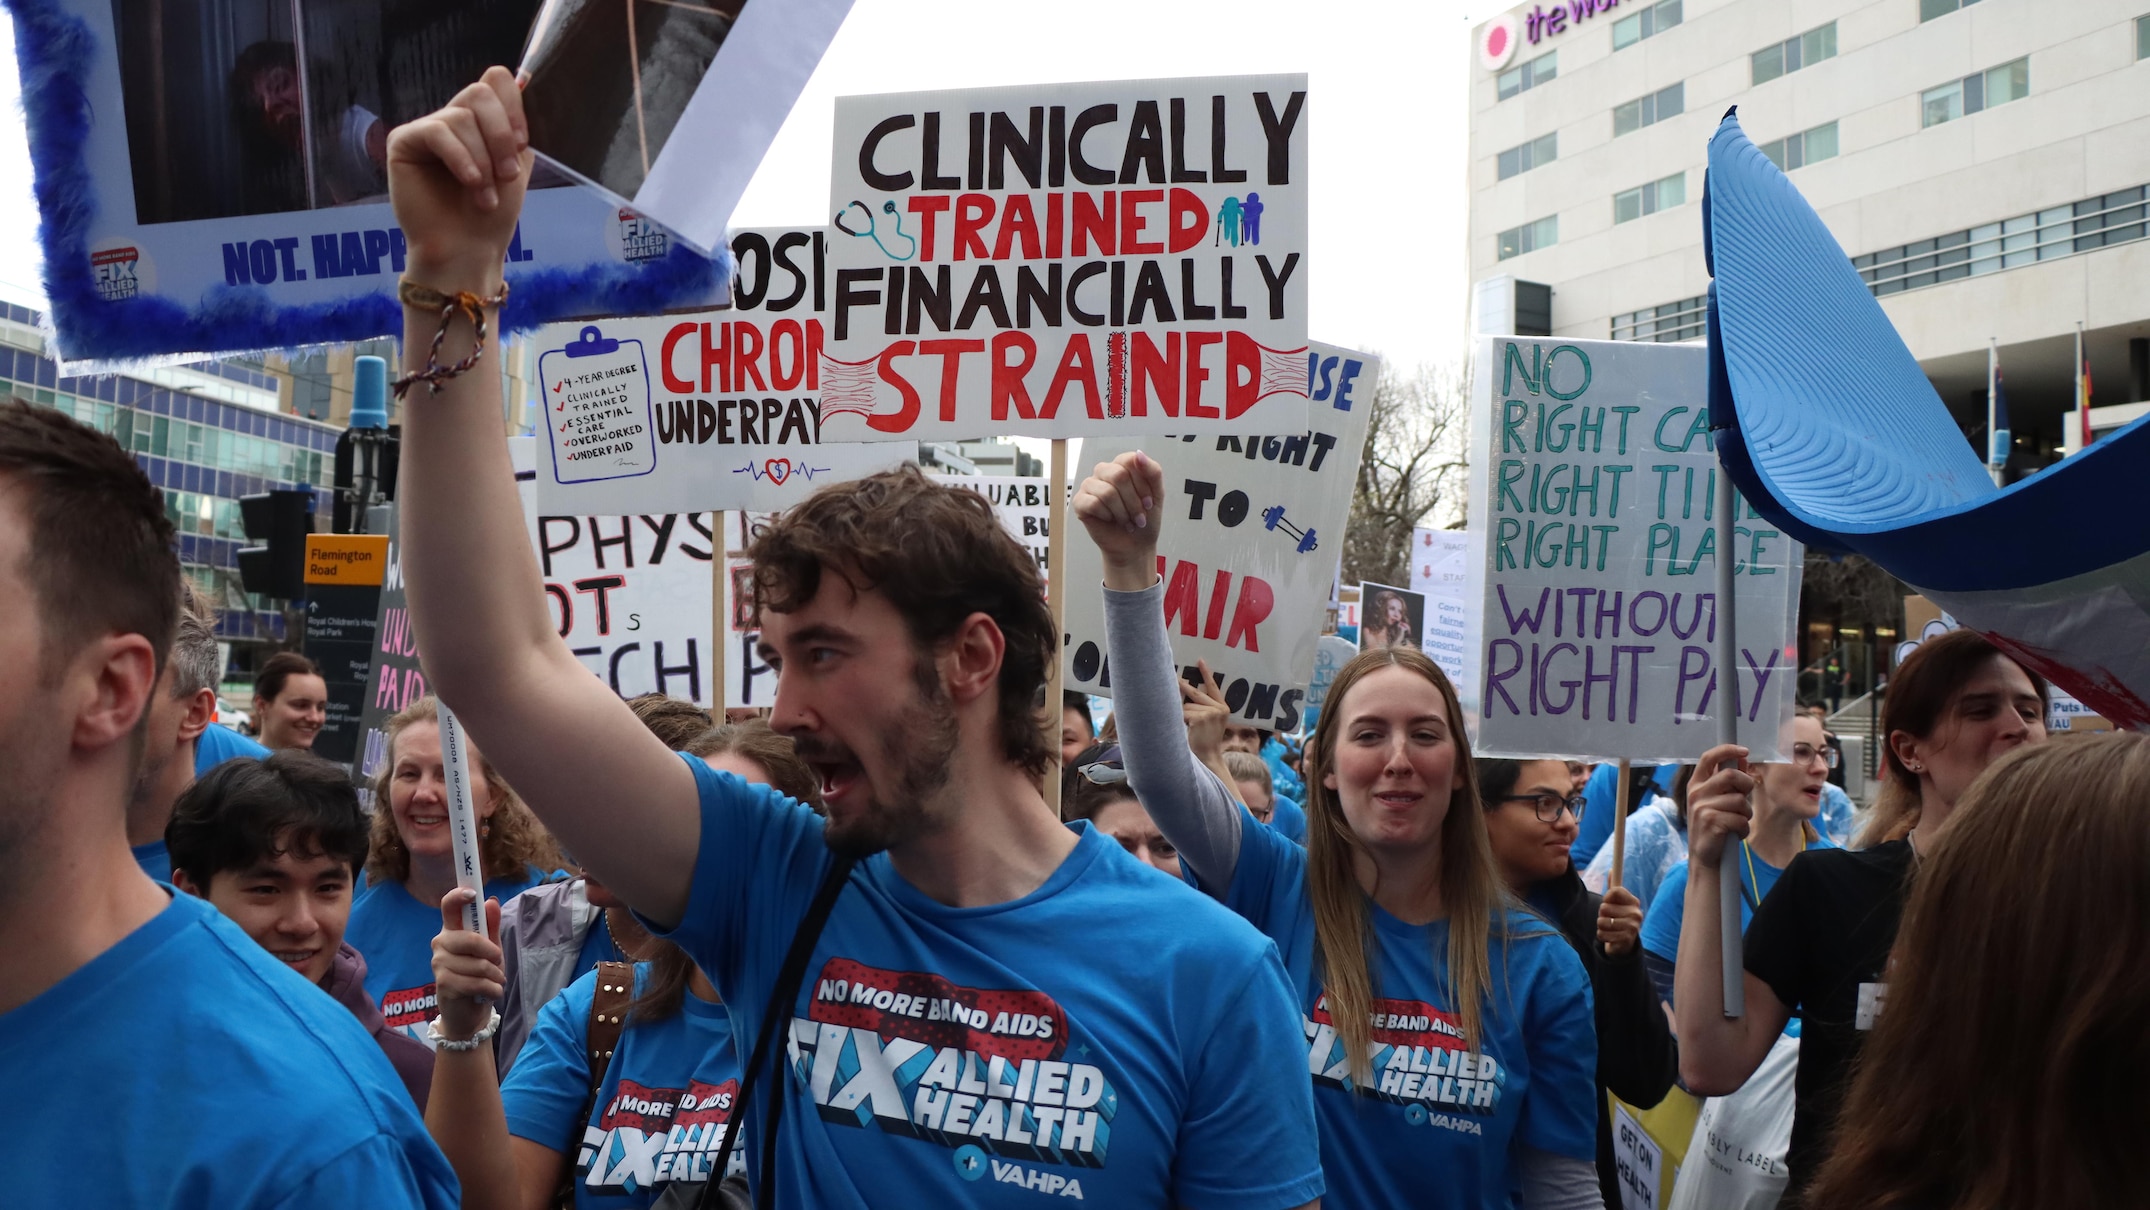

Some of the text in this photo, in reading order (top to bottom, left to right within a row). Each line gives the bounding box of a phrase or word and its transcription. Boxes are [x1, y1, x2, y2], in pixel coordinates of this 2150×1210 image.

[1526, 5, 1567, 45] the
[859, 91, 1306, 191] CLINICALLY
[908, 188, 1210, 261] TRAINED
[625, 234, 664, 249] ALLIED
[625, 245, 664, 259] HEALTH
[94, 260, 135, 283] FIX
[222, 237, 307, 287] NOT.
[732, 231, 828, 312] OSI
[97, 278, 135, 293] ALLIED
[104, 288, 136, 301] EALTH
[834, 252, 1300, 341] FINANCIALLY
[605, 364, 638, 378] DEGREE
[866, 329, 1262, 433] STRAINED
[1502, 342, 1592, 401] NO
[567, 383, 627, 403] CLINICALLY
[573, 394, 628, 412] TRAINED
[567, 406, 633, 428] ESSENTIAL
[578, 422, 605, 434] CARE
[1502, 400, 1714, 455] RIGHT CA
[571, 424, 643, 447] OVERWORKED
[573, 441, 634, 461] UNDERPAID
[1497, 459, 1633, 518] RIGHT
[1184, 479, 1250, 528] TO
[311, 548, 372, 564] Flemington
[1495, 517, 1619, 572] RIGHT
[310, 563, 338, 576] Road
[1443, 573, 1467, 582] STAF
[1156, 555, 1275, 653] AIR
[1437, 602, 1463, 613] Can't
[1496, 583, 1716, 643] WITHOUT
[307, 617, 327, 628] Royal
[327, 617, 361, 628] Children's
[307, 628, 342, 639] Royal Park
[381, 608, 422, 658] UND
[1439, 614, 1465, 628] fairne
[1443, 653, 1463, 665] work
[354, 671, 368, 681] Roy
[376, 664, 425, 713] PAID
[1484, 638, 1780, 725] RIGHT PAY
[2053, 702, 2080, 712] Puts
[384, 1002, 403, 1017] NO
[817, 978, 1054, 1039] NO MORE BAND AIDS
[1387, 1014, 1430, 1032] BAND
[1430, 1019, 1466, 1041] AIDS
[787, 1016, 1105, 1121] FIX ALLIED
[1385, 1044, 1497, 1081] ALLIED
[1379, 1069, 1495, 1108] HEALTH
[620, 1094, 674, 1118] MORE
[913, 1086, 1100, 1153] HEALTH
[1429, 1111, 1483, 1136] VAHPA
[577, 1124, 668, 1187] FIX
[1620, 1123, 1653, 1172] GET ON
[1737, 1147, 1776, 1175] LABEL
[990, 1158, 1085, 1200] VAHPA
[1617, 1156, 1652, 1208] HEALTH
